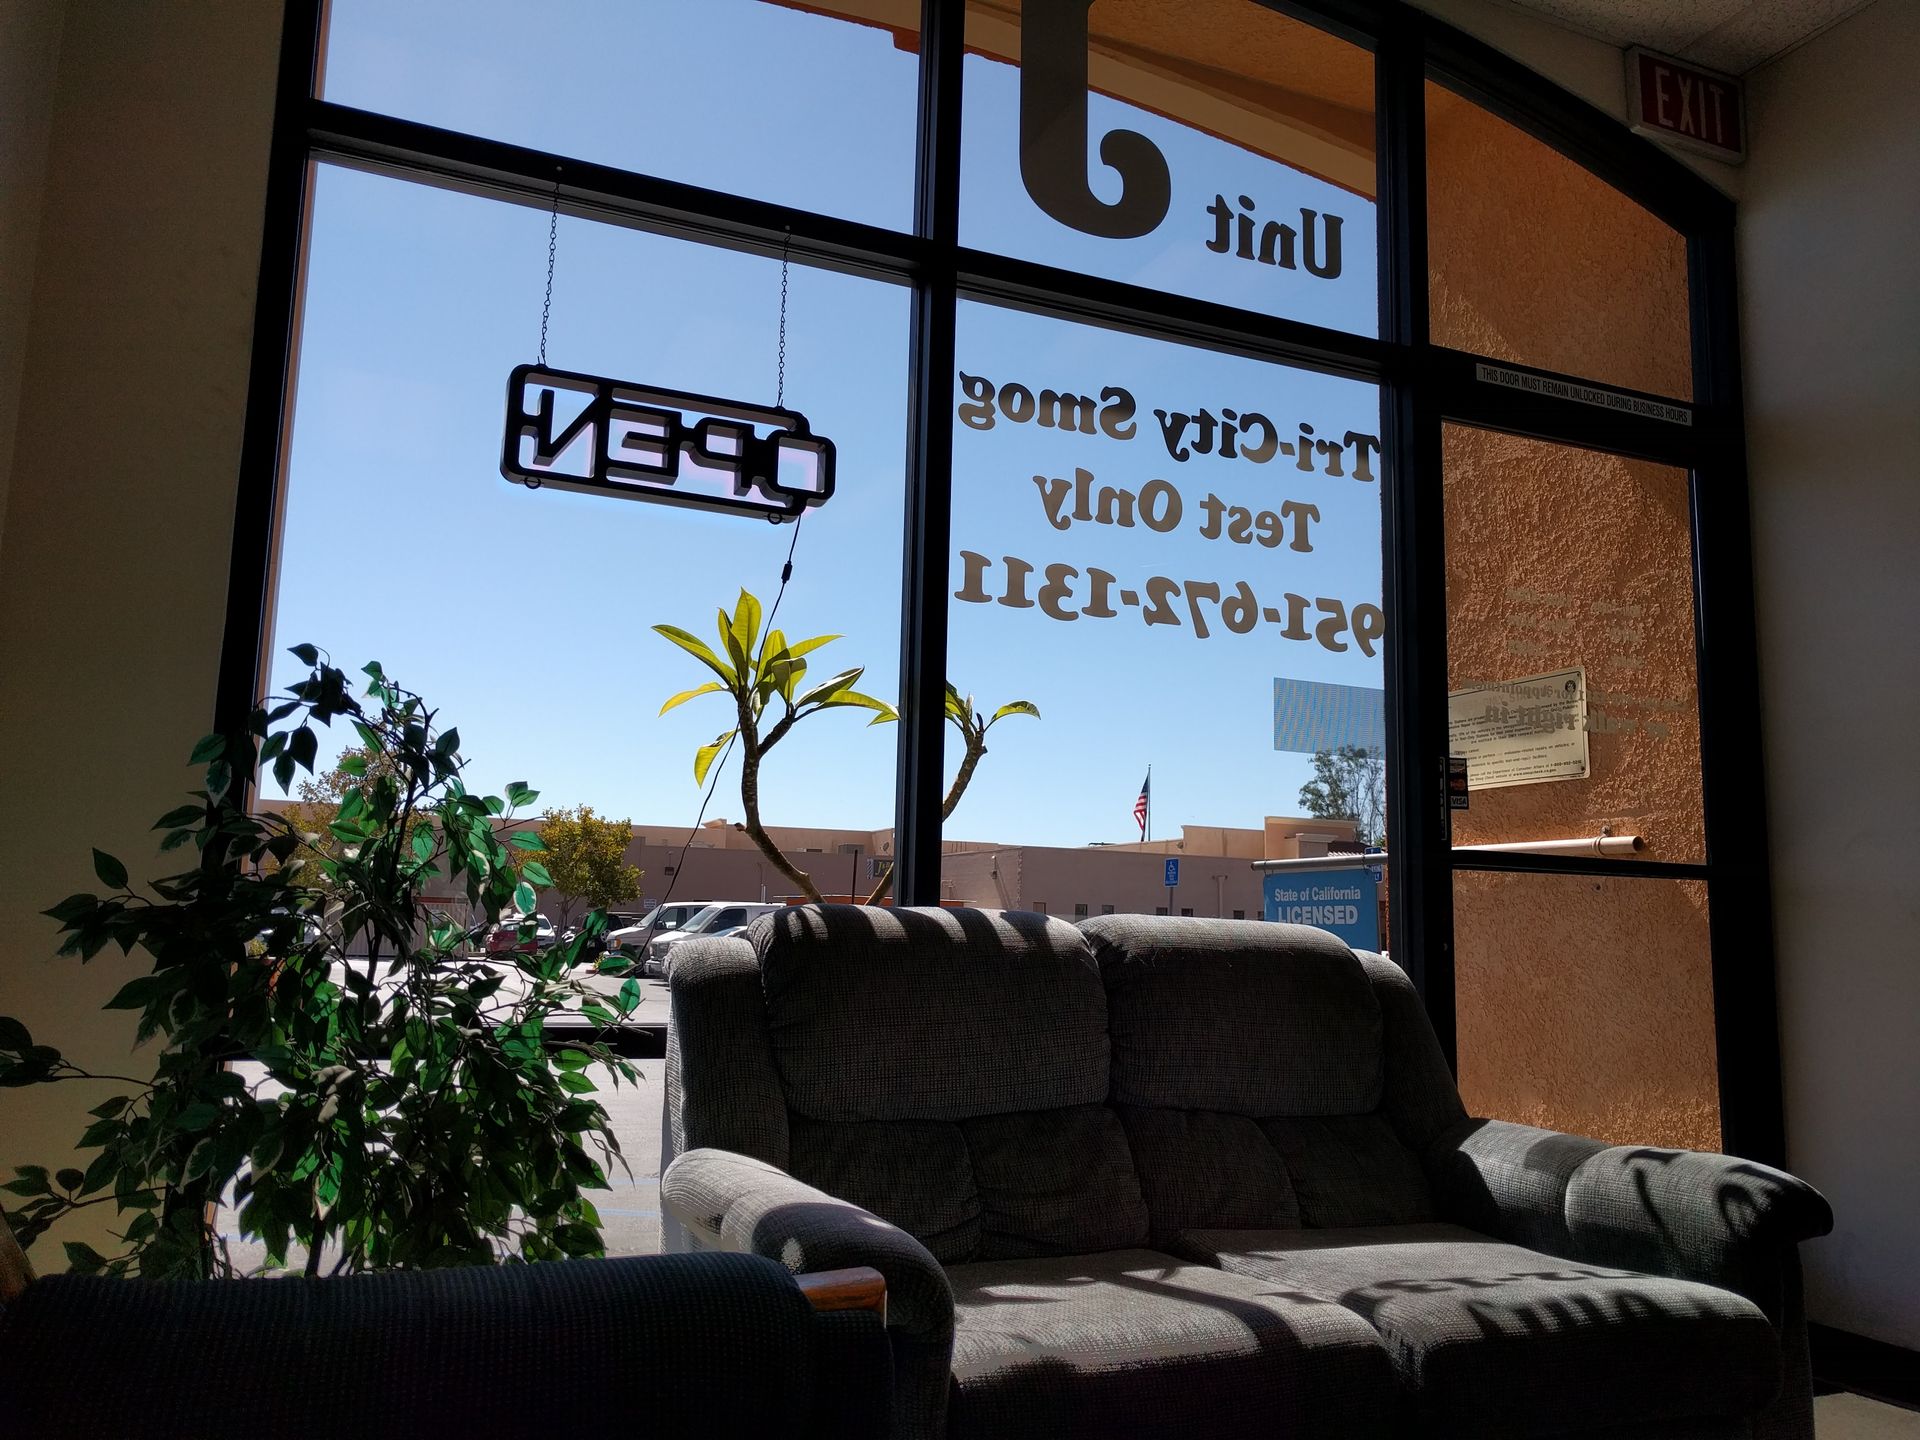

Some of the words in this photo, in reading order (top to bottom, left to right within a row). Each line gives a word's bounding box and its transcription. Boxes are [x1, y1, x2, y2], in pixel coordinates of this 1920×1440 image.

[1655, 65, 1725, 144] EXIT
[1482, 367, 1498, 382] THIS
[1500, 371, 1520, 387] DOOR
[1522, 375, 1541, 391] MUST
[1543, 380, 1569, 398] REMAIN
[1571, 385, 1605, 405] UNLOCKED
[1606, 394, 1632, 411] DURING
[1633, 400, 1665, 418] BUSINESS
[1666, 407, 1689, 423] HOURS
[1451, 796, 1467, 806] VISA
[1274, 888, 1298, 902] State
[1300, 888, 1310, 901] of
[1311, 885, 1361, 901] California
[1278, 905, 1359, 925] LICENSED
